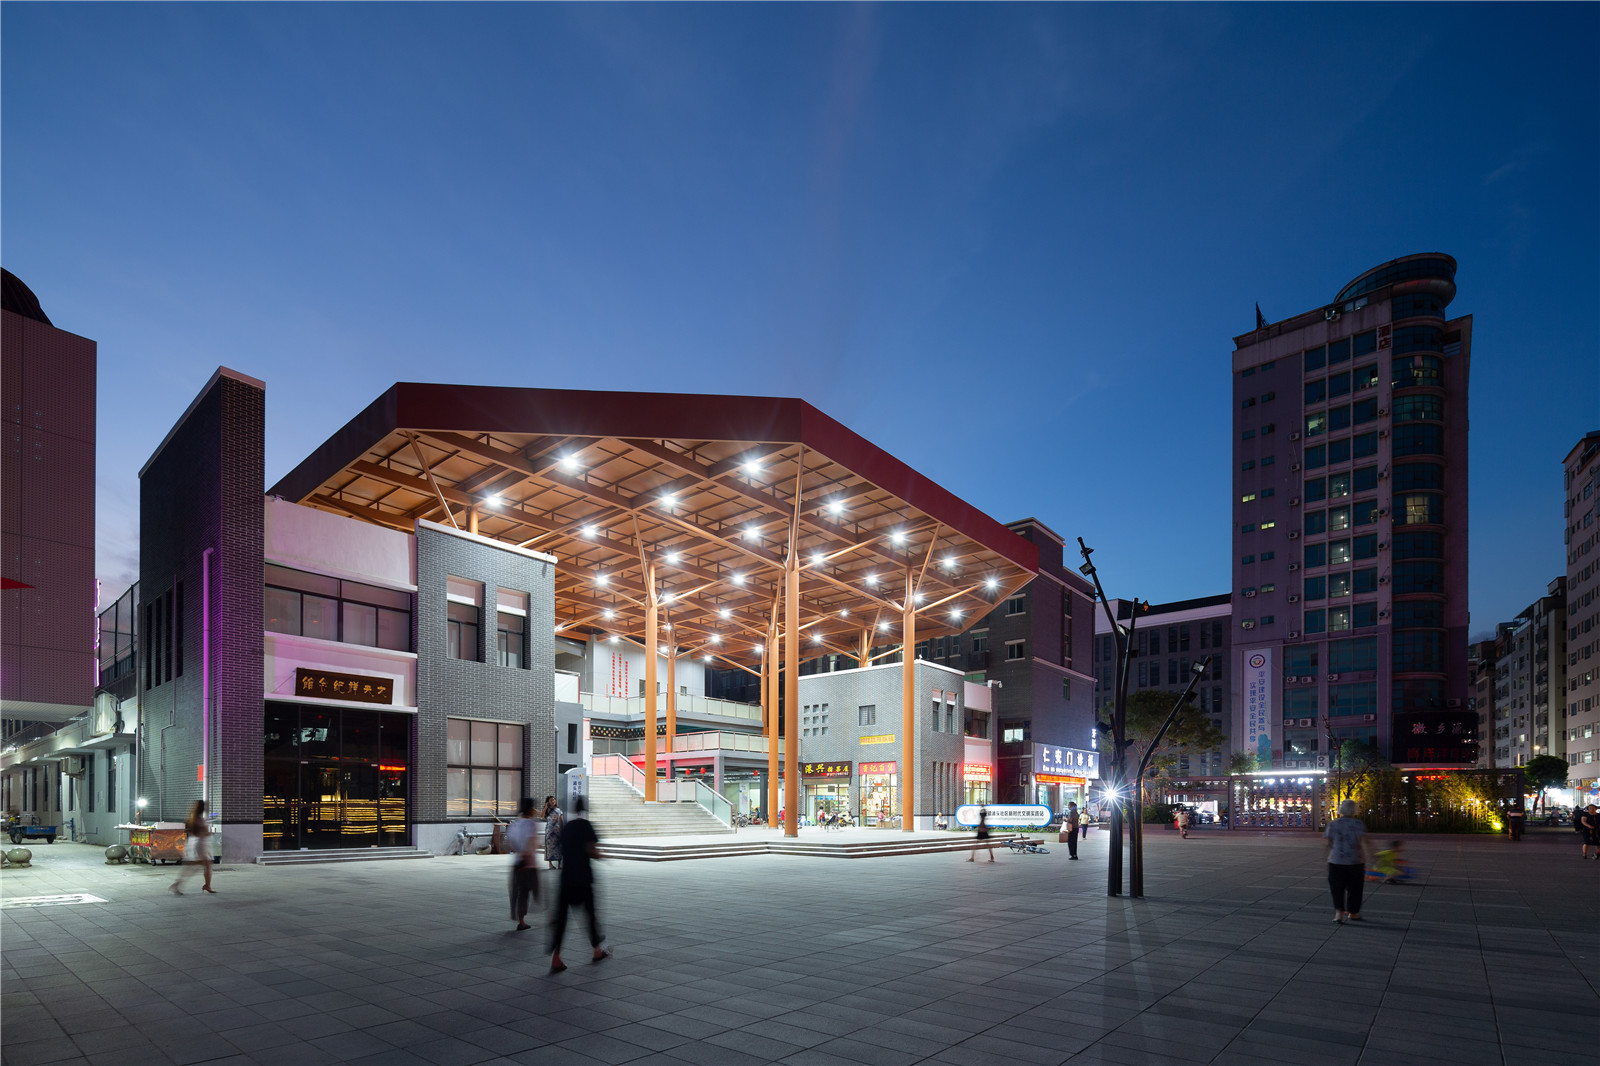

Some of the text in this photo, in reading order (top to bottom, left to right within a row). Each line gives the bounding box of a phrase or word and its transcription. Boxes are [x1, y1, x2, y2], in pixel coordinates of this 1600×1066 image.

[1043, 747, 1094, 768] 仁安门诊部
